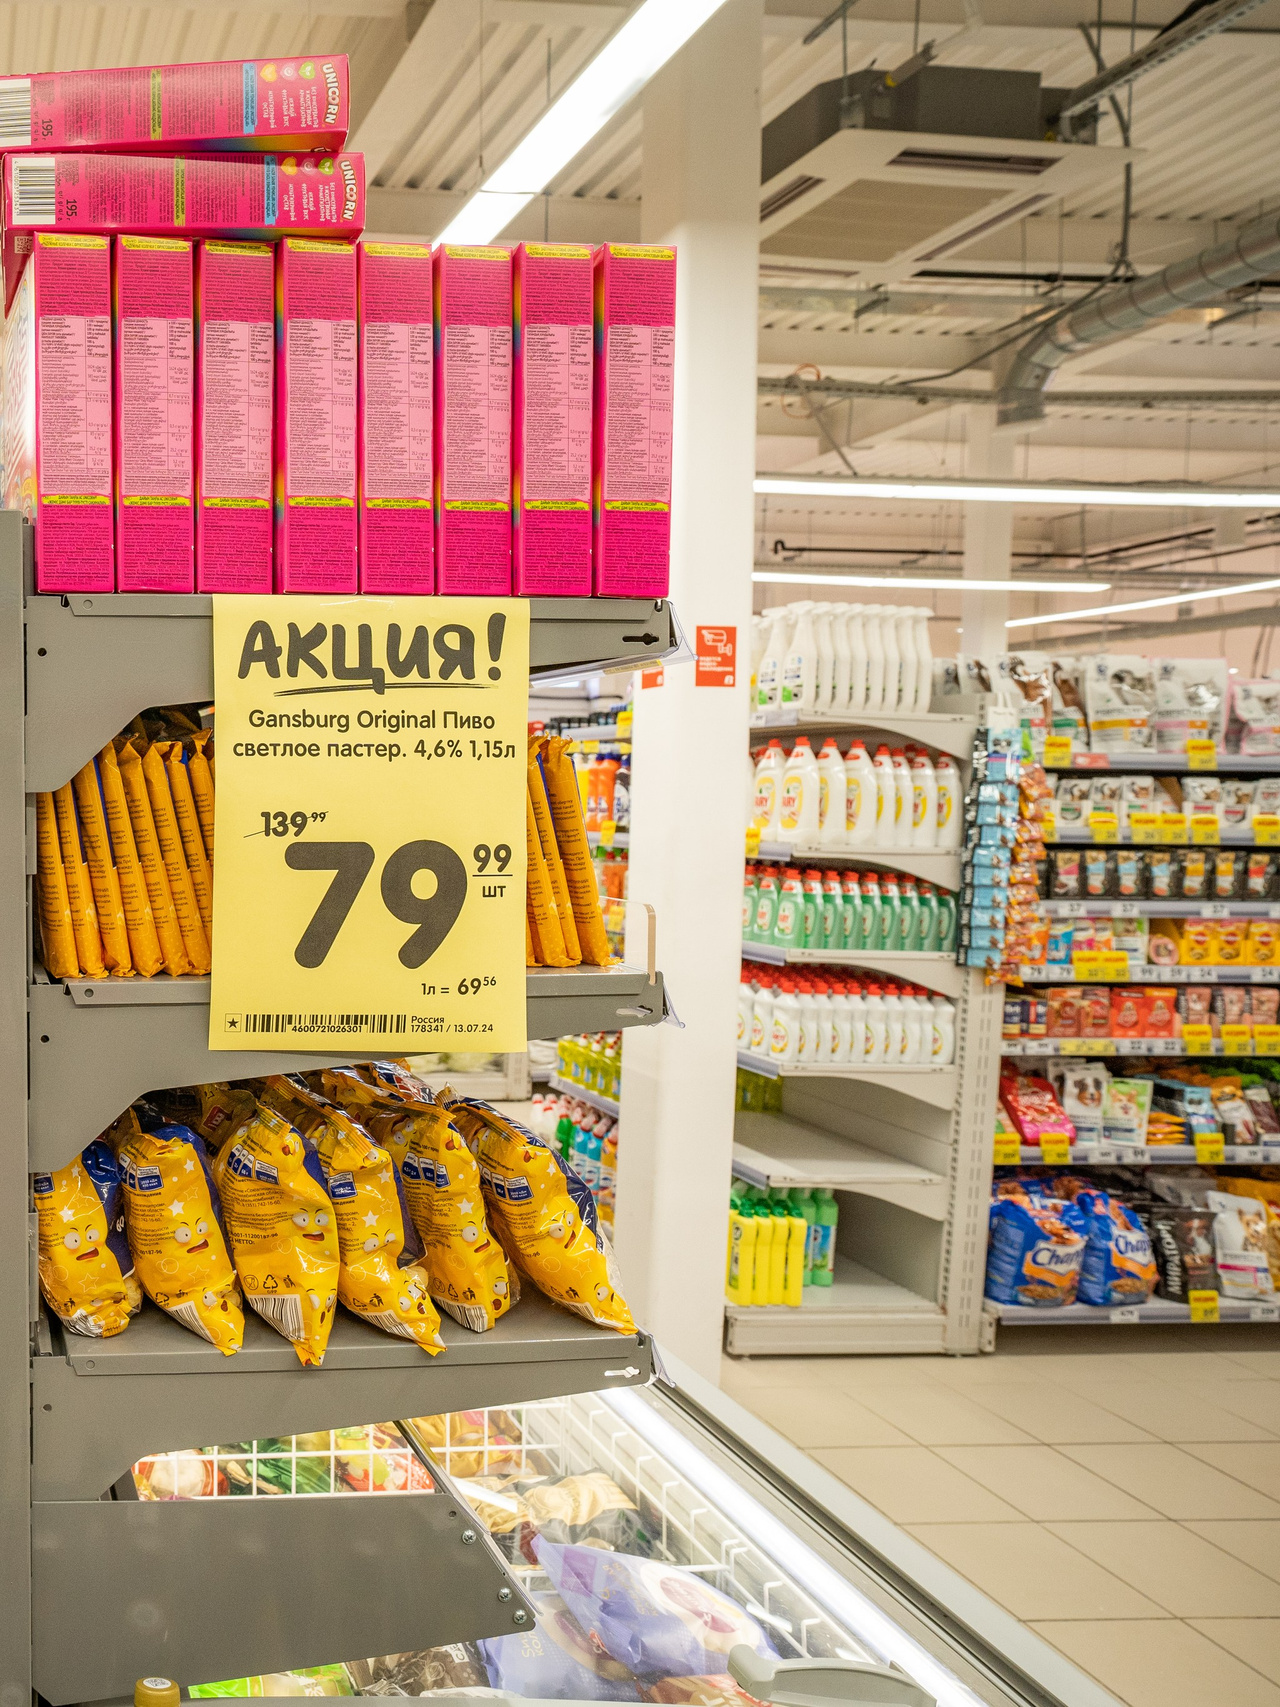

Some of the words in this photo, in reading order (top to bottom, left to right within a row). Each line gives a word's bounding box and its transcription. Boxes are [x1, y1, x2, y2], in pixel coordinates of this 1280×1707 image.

[322, 63, 340, 124] UNICORN
[41, 118, 53, 137] 195
[338, 160, 356, 221] UNICORN
[66, 199, 77, 217] 195
[238, 613, 506, 696] АКЦИЯ!
[249, 709, 349, 733] Gansburg
[357, 710, 435, 733] Original
[444, 711, 495, 729] Пиво
[233, 743, 320, 757] светлое
[328, 744, 406, 762] пастер.
[414, 740, 462, 760] 4,6%
[470, 740, 515, 760] 1,15л
[483, 886, 506, 897] шт
[285, 840, 467, 969] 79
[474, 844, 512, 875] 99
[422, 983, 435, 995] 1л
[411, 1016, 444, 1026] Россия
[454, 1024, 493, 1032] 13.07.24
